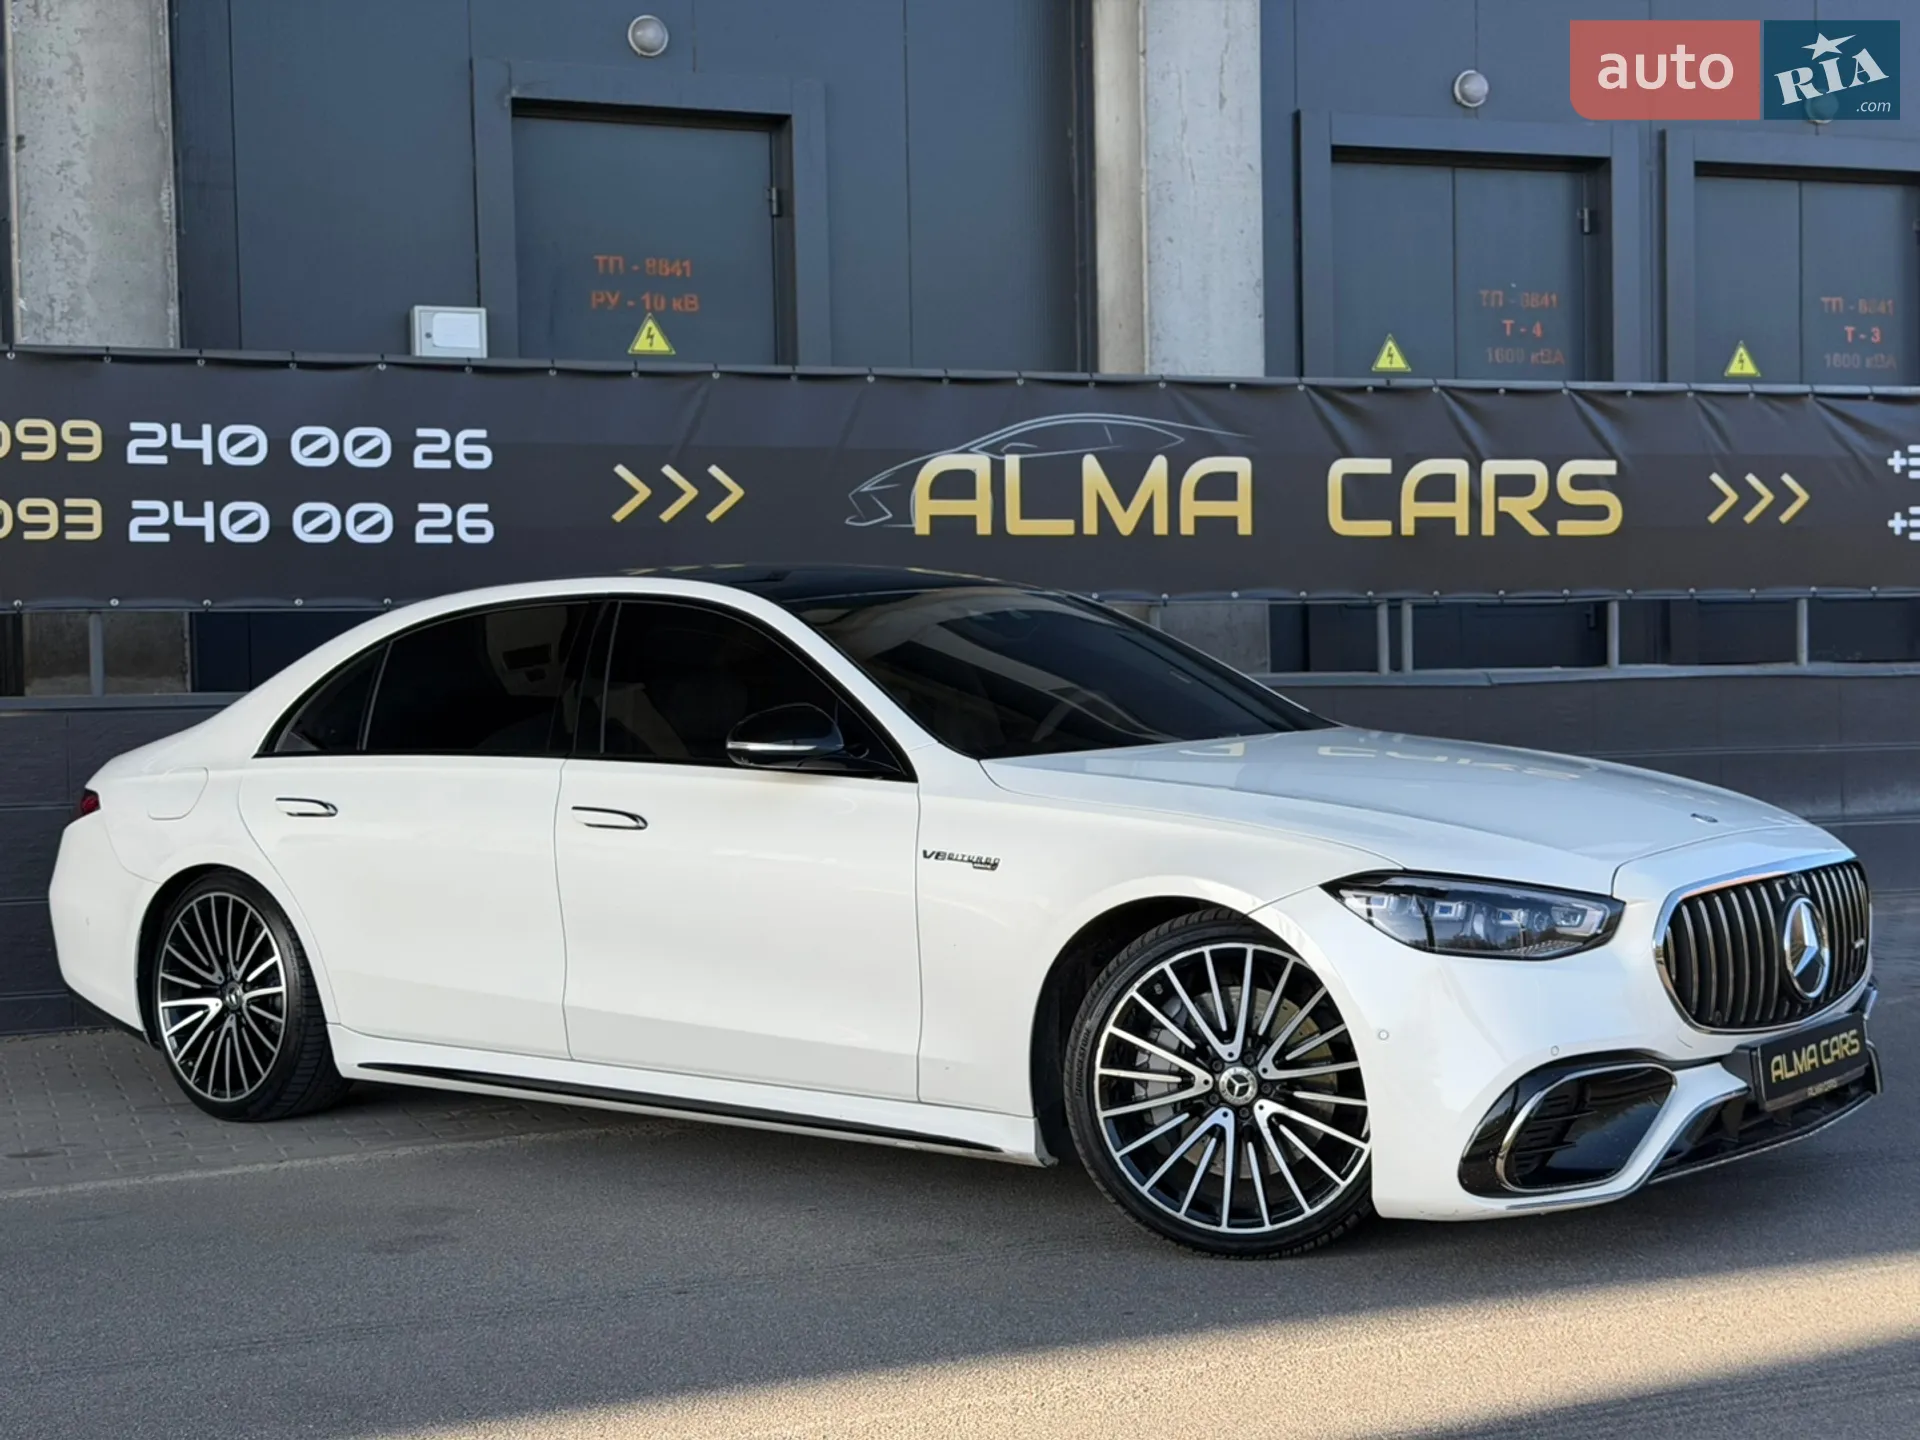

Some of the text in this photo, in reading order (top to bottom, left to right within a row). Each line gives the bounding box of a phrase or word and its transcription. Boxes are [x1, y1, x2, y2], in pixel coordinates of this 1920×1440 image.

[594, 256, 624, 275] ТП
[591, 290, 620, 310] РУ
[641, 292, 666, 311] 10
[1871, 327, 1881, 343] 3
[0, 418, 493, 469] 99 240 00 26
[914, 454, 1623, 537] ALMA CARS
[0, 497, 495, 543] 93 240 00 26
[1770, 1029, 1860, 1083] ALMA CARS
